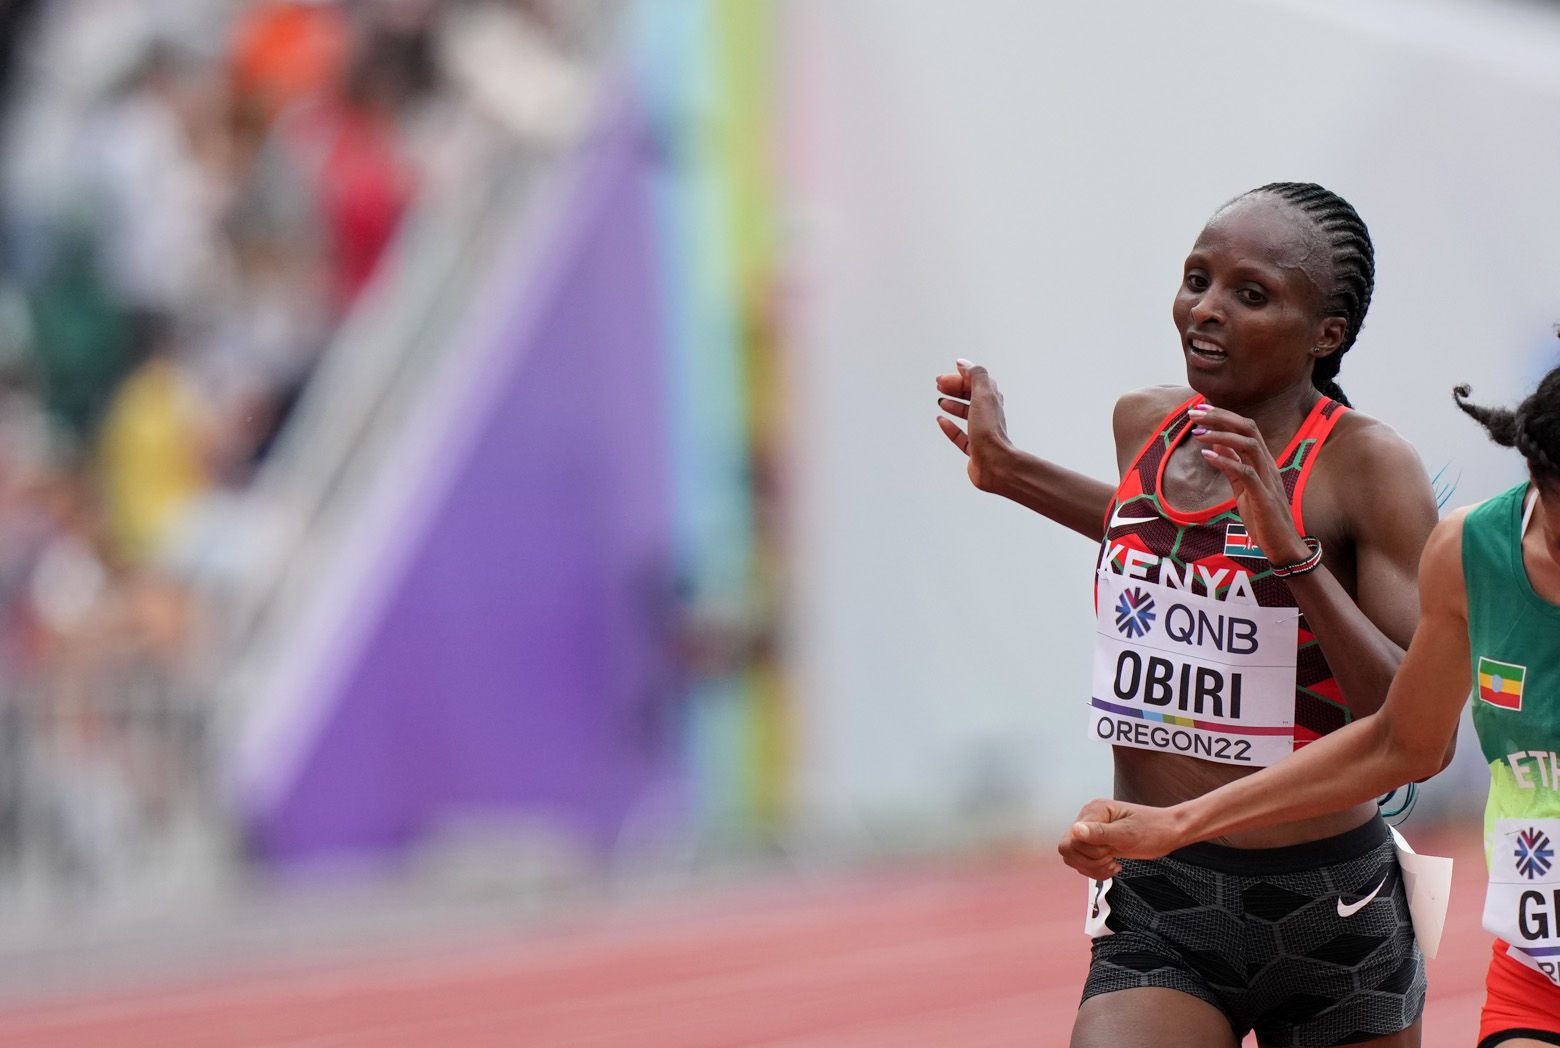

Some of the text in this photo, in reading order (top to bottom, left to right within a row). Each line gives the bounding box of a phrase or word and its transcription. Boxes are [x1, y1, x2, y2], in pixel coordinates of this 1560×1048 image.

[1099, 540, 1260, 607] KENYA
[1164, 603, 1259, 655] QNB
[1113, 650, 1242, 719] OBIRI
[1096, 716, 1252, 761] OREGON22
